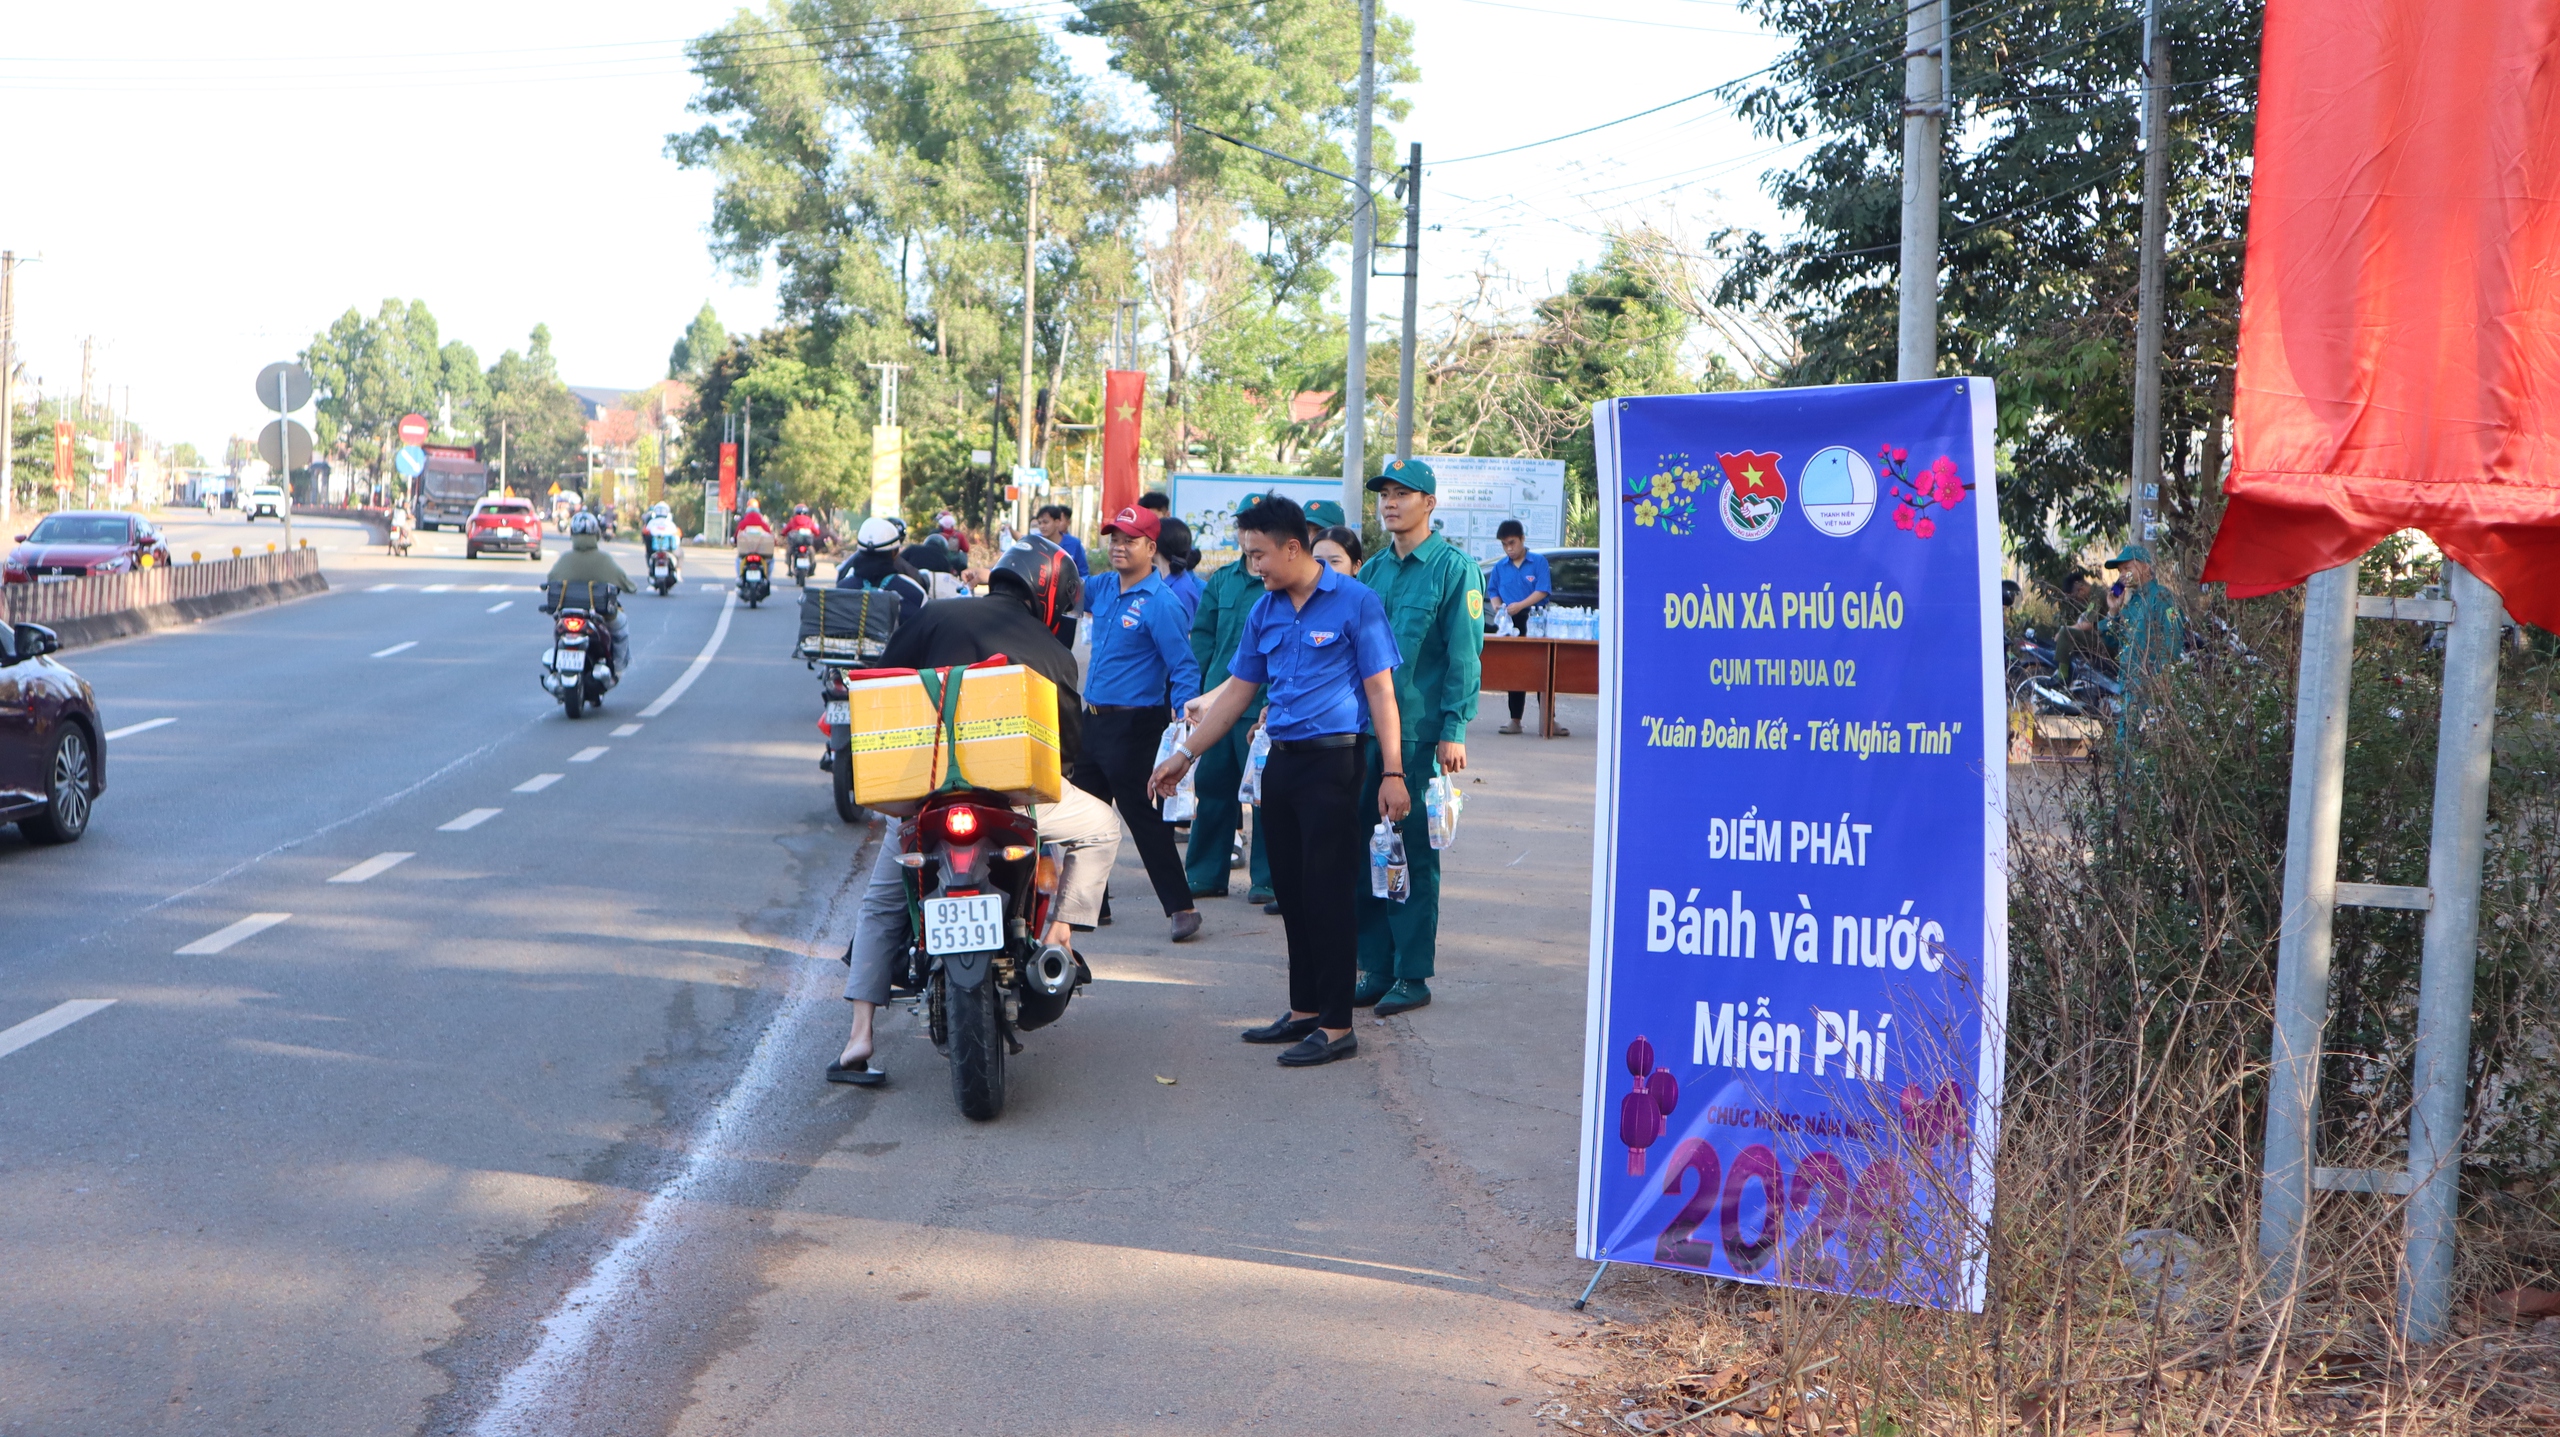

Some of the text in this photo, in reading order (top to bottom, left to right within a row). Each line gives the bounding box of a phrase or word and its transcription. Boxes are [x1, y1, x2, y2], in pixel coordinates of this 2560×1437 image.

[1824, 519, 1838, 527] VIỆT
[1664, 582, 1904, 630] ĐOÀN XÃ PHÚ GIÁO
[1710, 658, 1857, 691] CỤM THI ĐUA 02
[1701, 717, 1751, 749] Đoàn
[1755, 717, 1788, 751] Kết
[1808, 718, 1840, 751] Tết
[1844, 721, 1901, 760] Nghĩa
[1708, 805, 1873, 867] ĐIỂM PHÁT
[938, 900, 988, 924] 93-L1
[1647, 887, 1945, 973] Bánh và nước
[931, 923, 997, 950] 553.91
[1692, 997, 1892, 1082] Miễn Phí
[1707, 1102, 1750, 1128] CHÚC
[1804, 1111, 1842, 1138] NĂM
